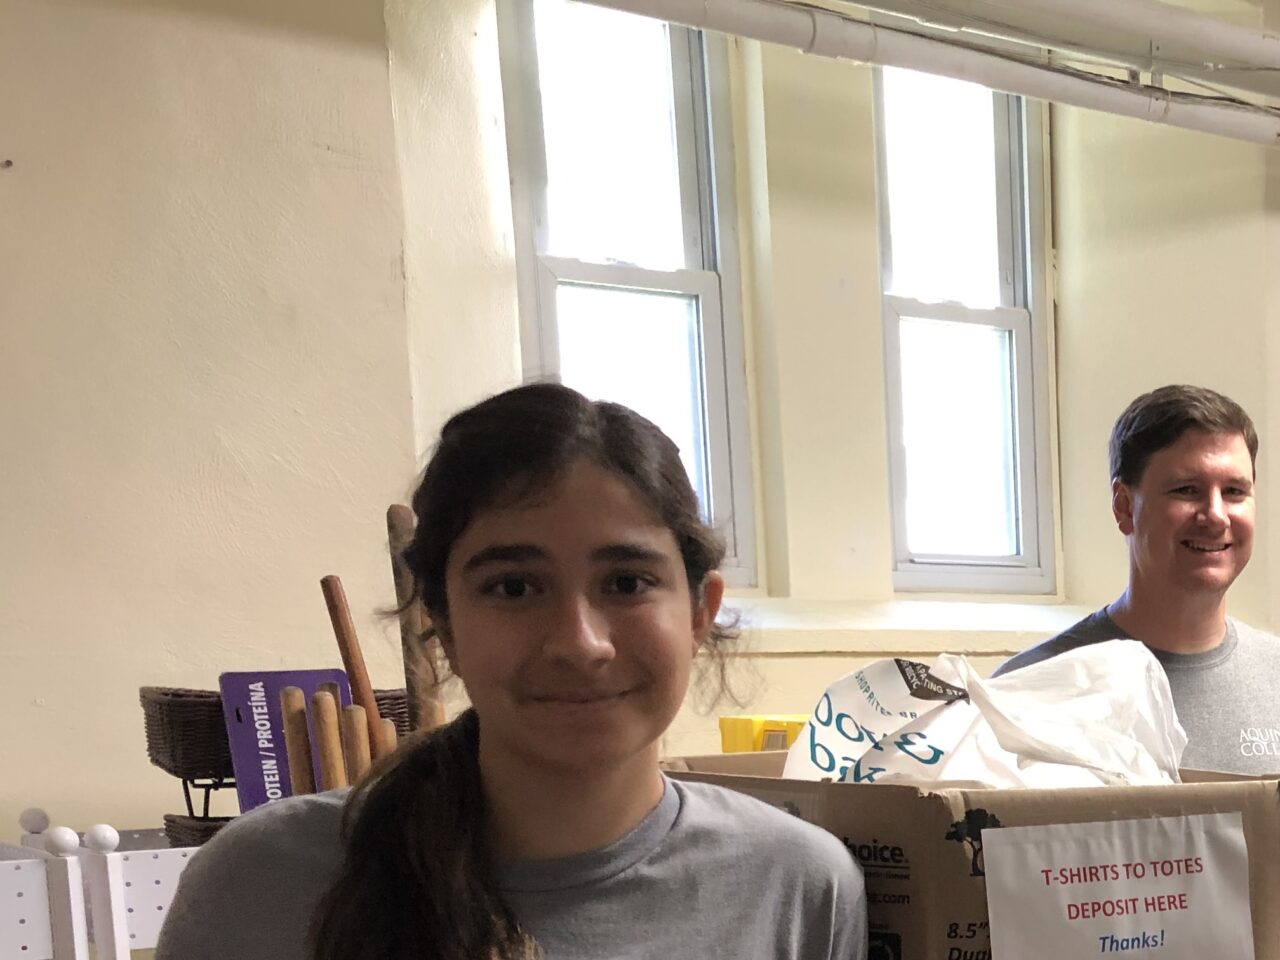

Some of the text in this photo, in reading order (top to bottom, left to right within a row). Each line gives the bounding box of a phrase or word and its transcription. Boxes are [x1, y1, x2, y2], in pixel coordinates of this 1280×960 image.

[247, 681, 274, 748] PROTEÍNA
[1041, 857, 1203, 886] T-SHIRTS TO TOTES
[1067, 893, 1188, 920] DEPOSIT HERE
[947, 922, 990, 939] 8.5"
[1099, 929, 1165, 953] Thanks!
